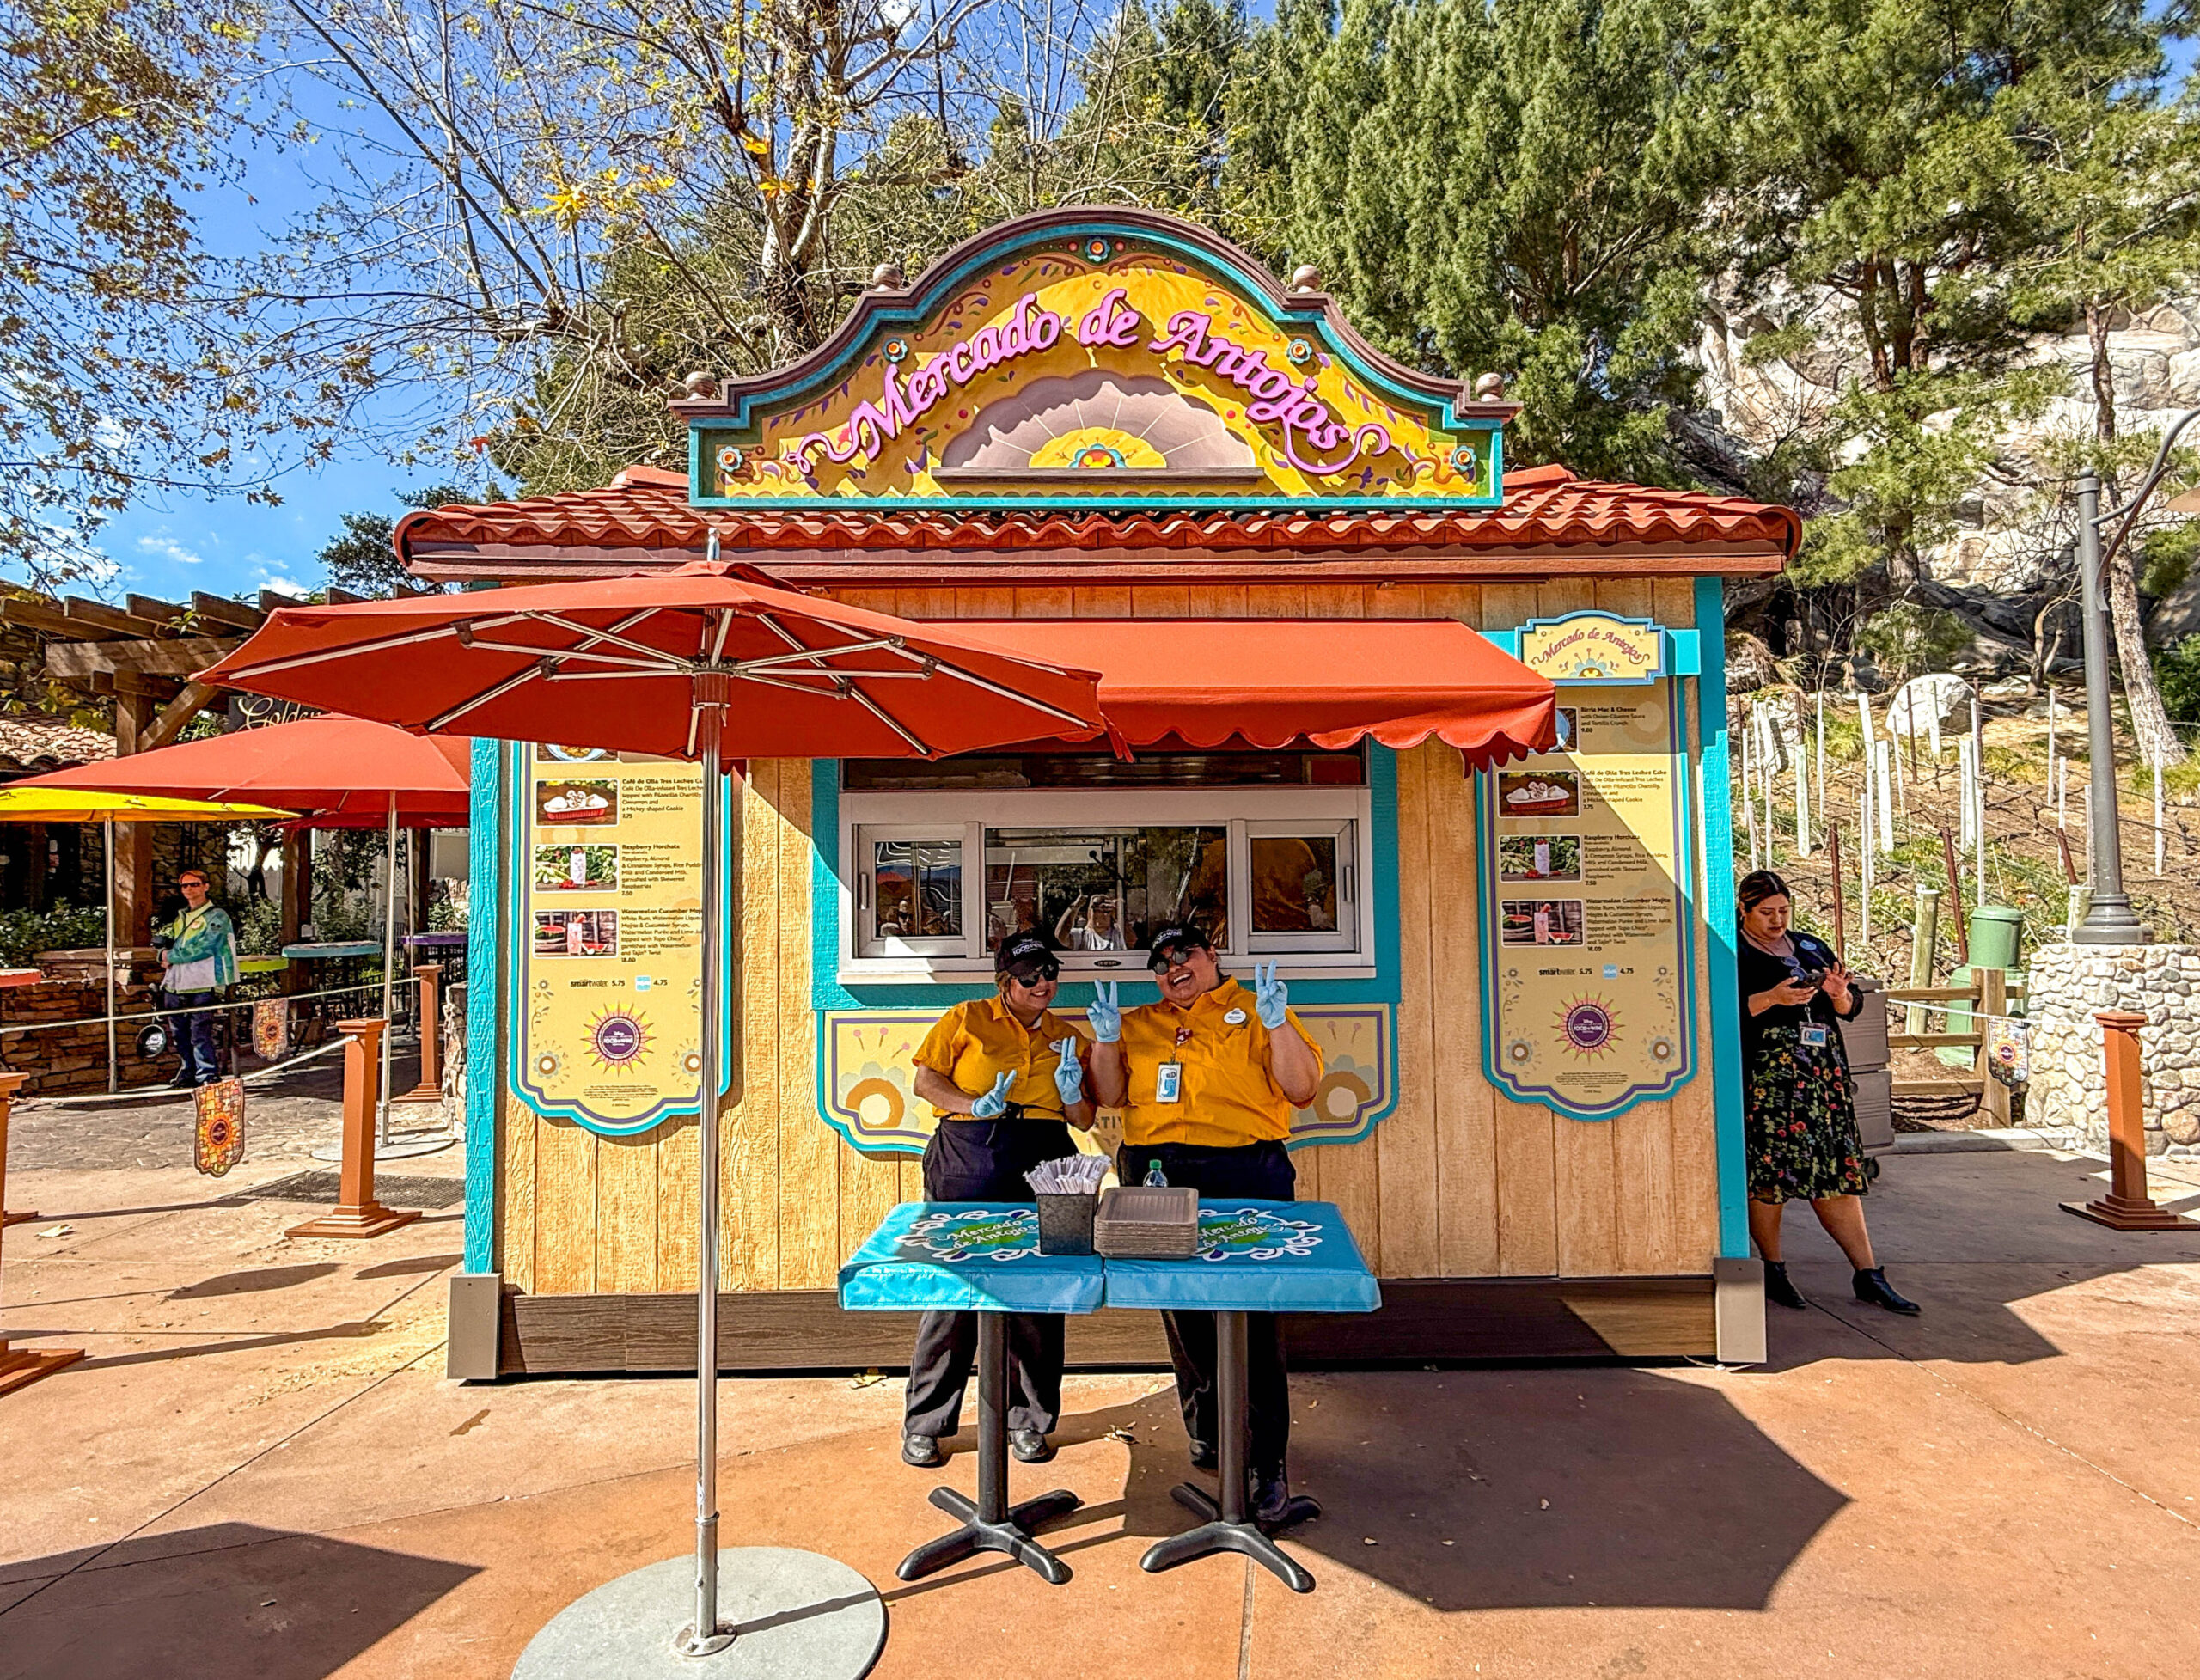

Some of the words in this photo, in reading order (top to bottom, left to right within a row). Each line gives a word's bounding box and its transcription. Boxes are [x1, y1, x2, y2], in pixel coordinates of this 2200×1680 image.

[786, 292, 1063, 473] Mercado
[1079, 289, 1140, 347] de
[1147, 310, 1391, 475] Antojos
[1531, 628, 1585, 665] Mercado
[1587, 627, 1600, 639] de
[1601, 632, 1651, 665] Antojos
[930, 1219, 1024, 1241] Mercado
[953, 1239, 973, 1249] de
[972, 1224, 1039, 1244] Antojos
